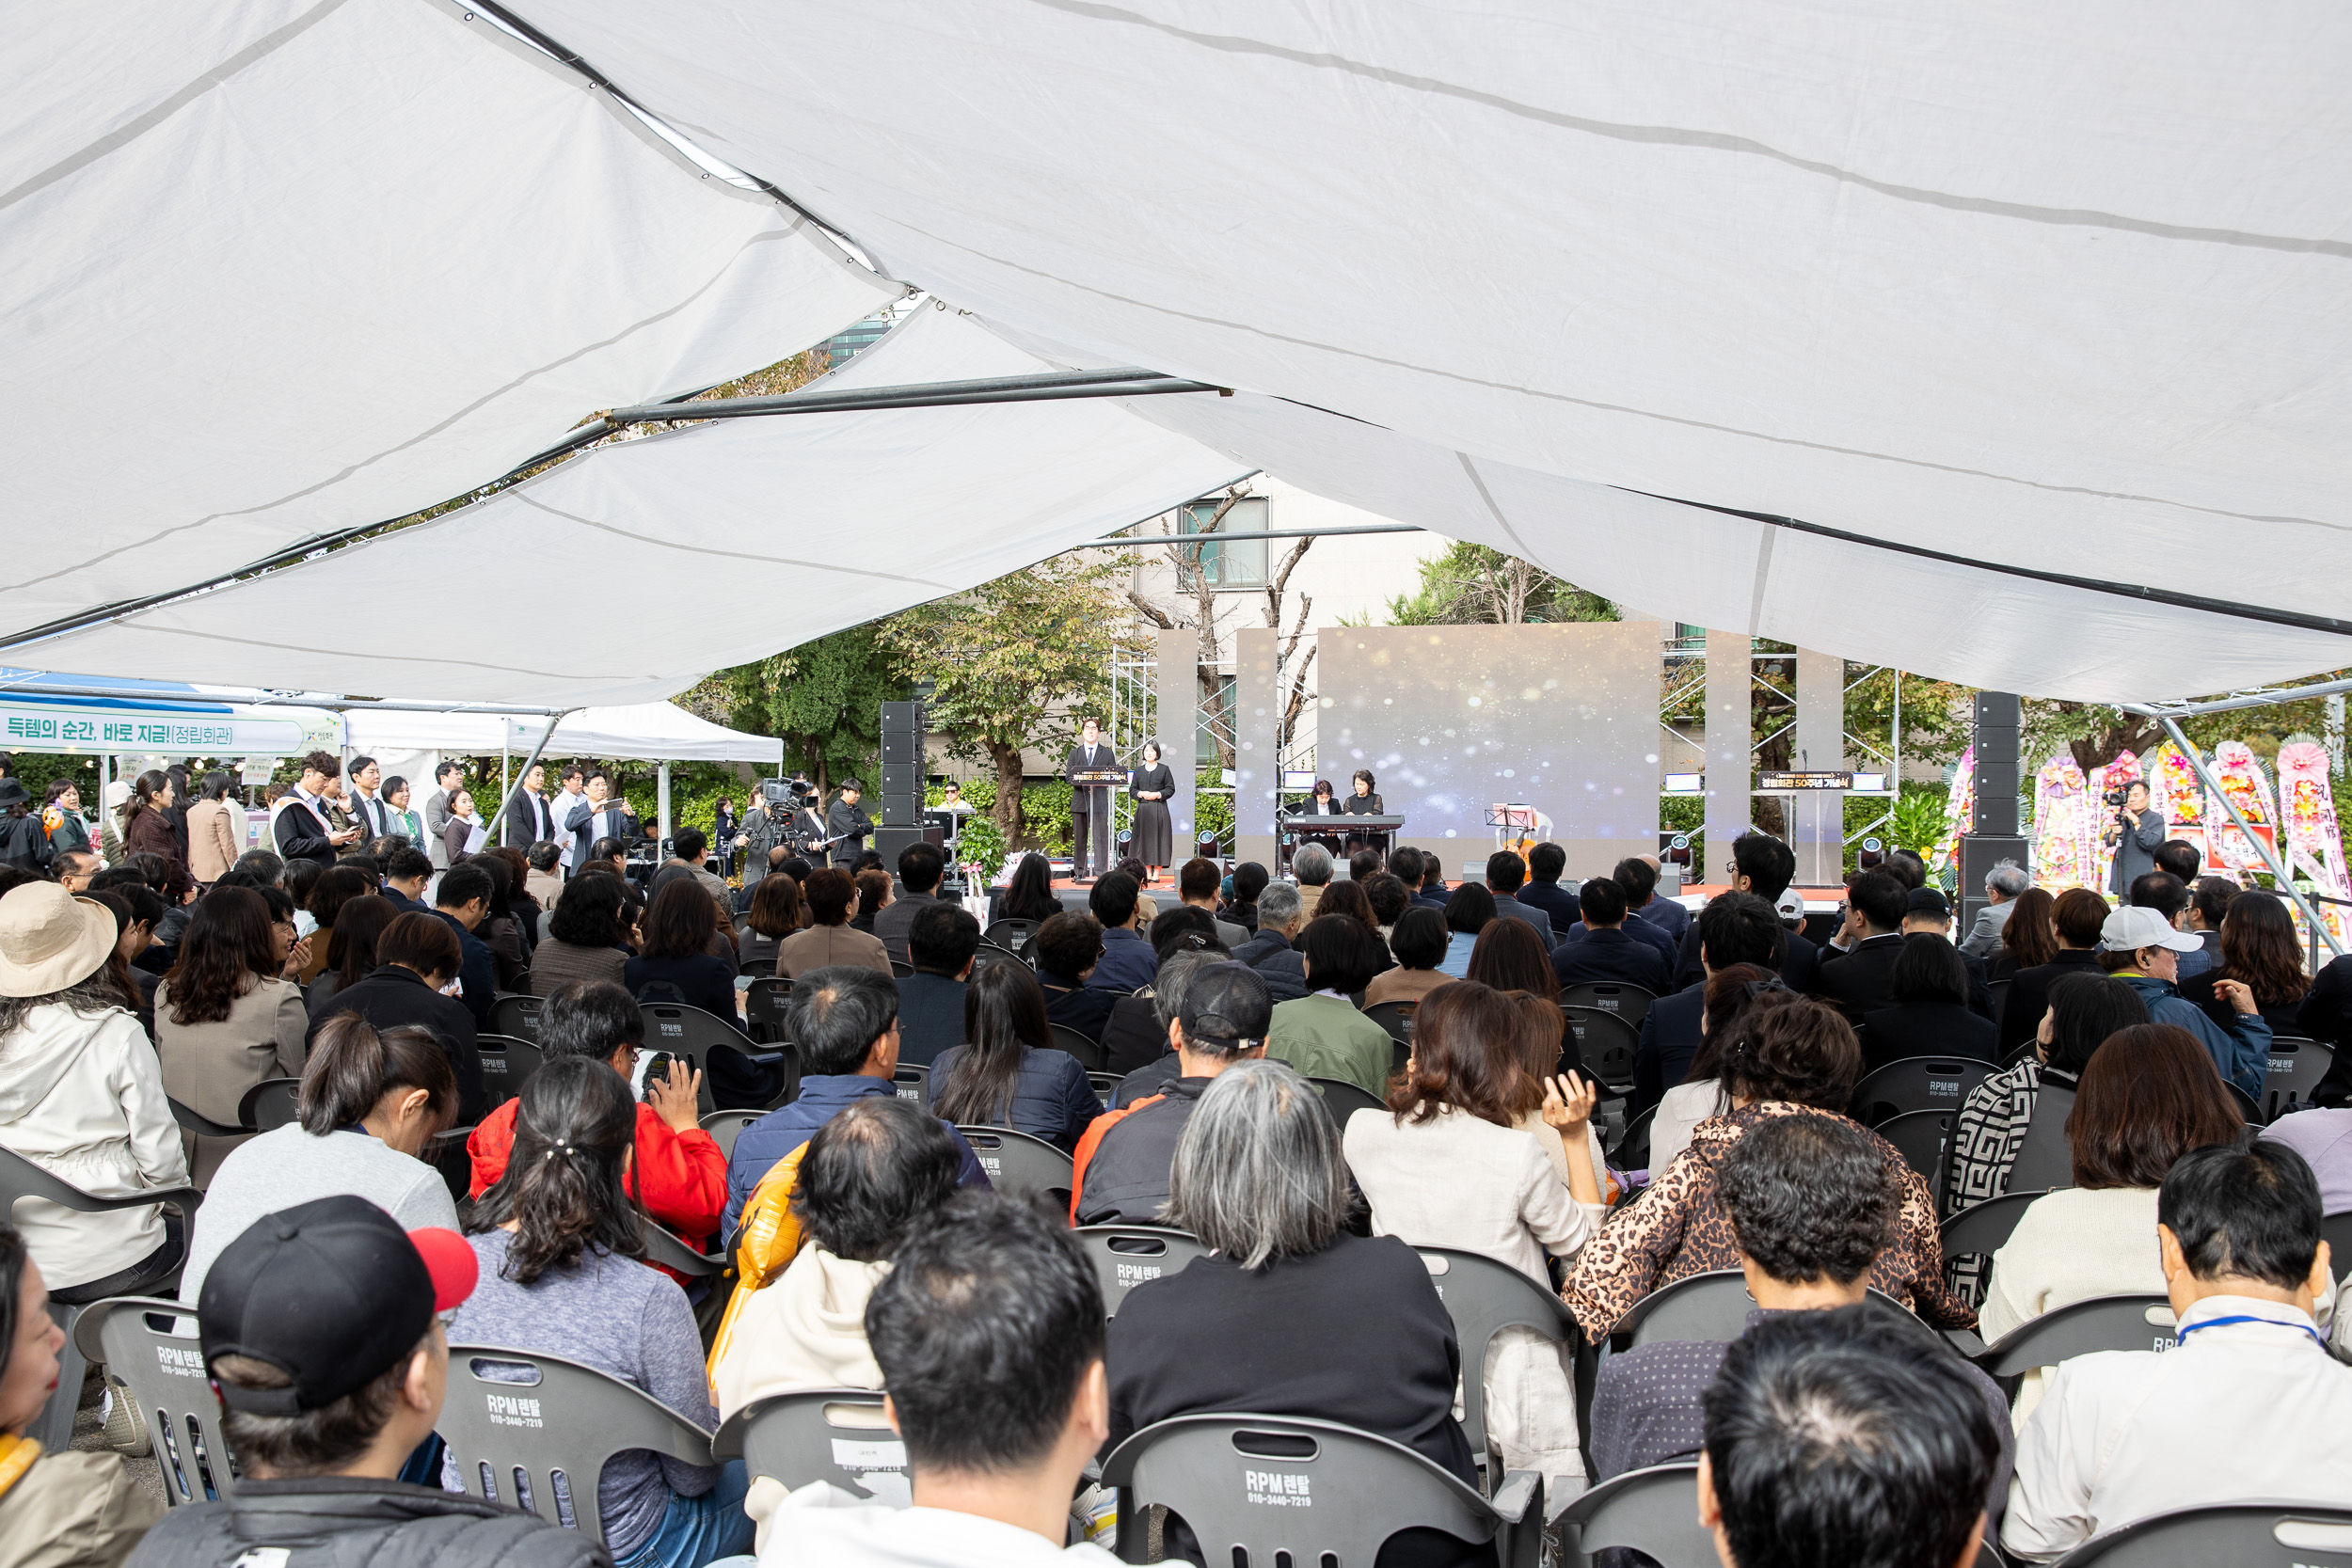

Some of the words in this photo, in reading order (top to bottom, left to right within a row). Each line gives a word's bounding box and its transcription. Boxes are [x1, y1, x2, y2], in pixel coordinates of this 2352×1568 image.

[8, 717, 57, 739] 득템의
[62, 721, 97, 741] 순간,
[103, 723, 133, 742] 바로
[1762, 777, 1794, 788] 정립회관
[1795, 777, 1823, 788] 50주년
[1824, 777, 1850, 788] 기념식
[1930, 1081, 1960, 1091] RPM렌탈
[897, 1088, 919, 1100] PM렌탈
[161, 1365, 207, 1378] 010-3440-7219
[486, 1394, 541, 1418] RPM렌탈
[490, 1414, 544, 1428] 010-3440-7219
[1246, 1470, 1311, 1496] RPM렌탈
[1248, 1492, 1312, 1507] 010-3440-7219
